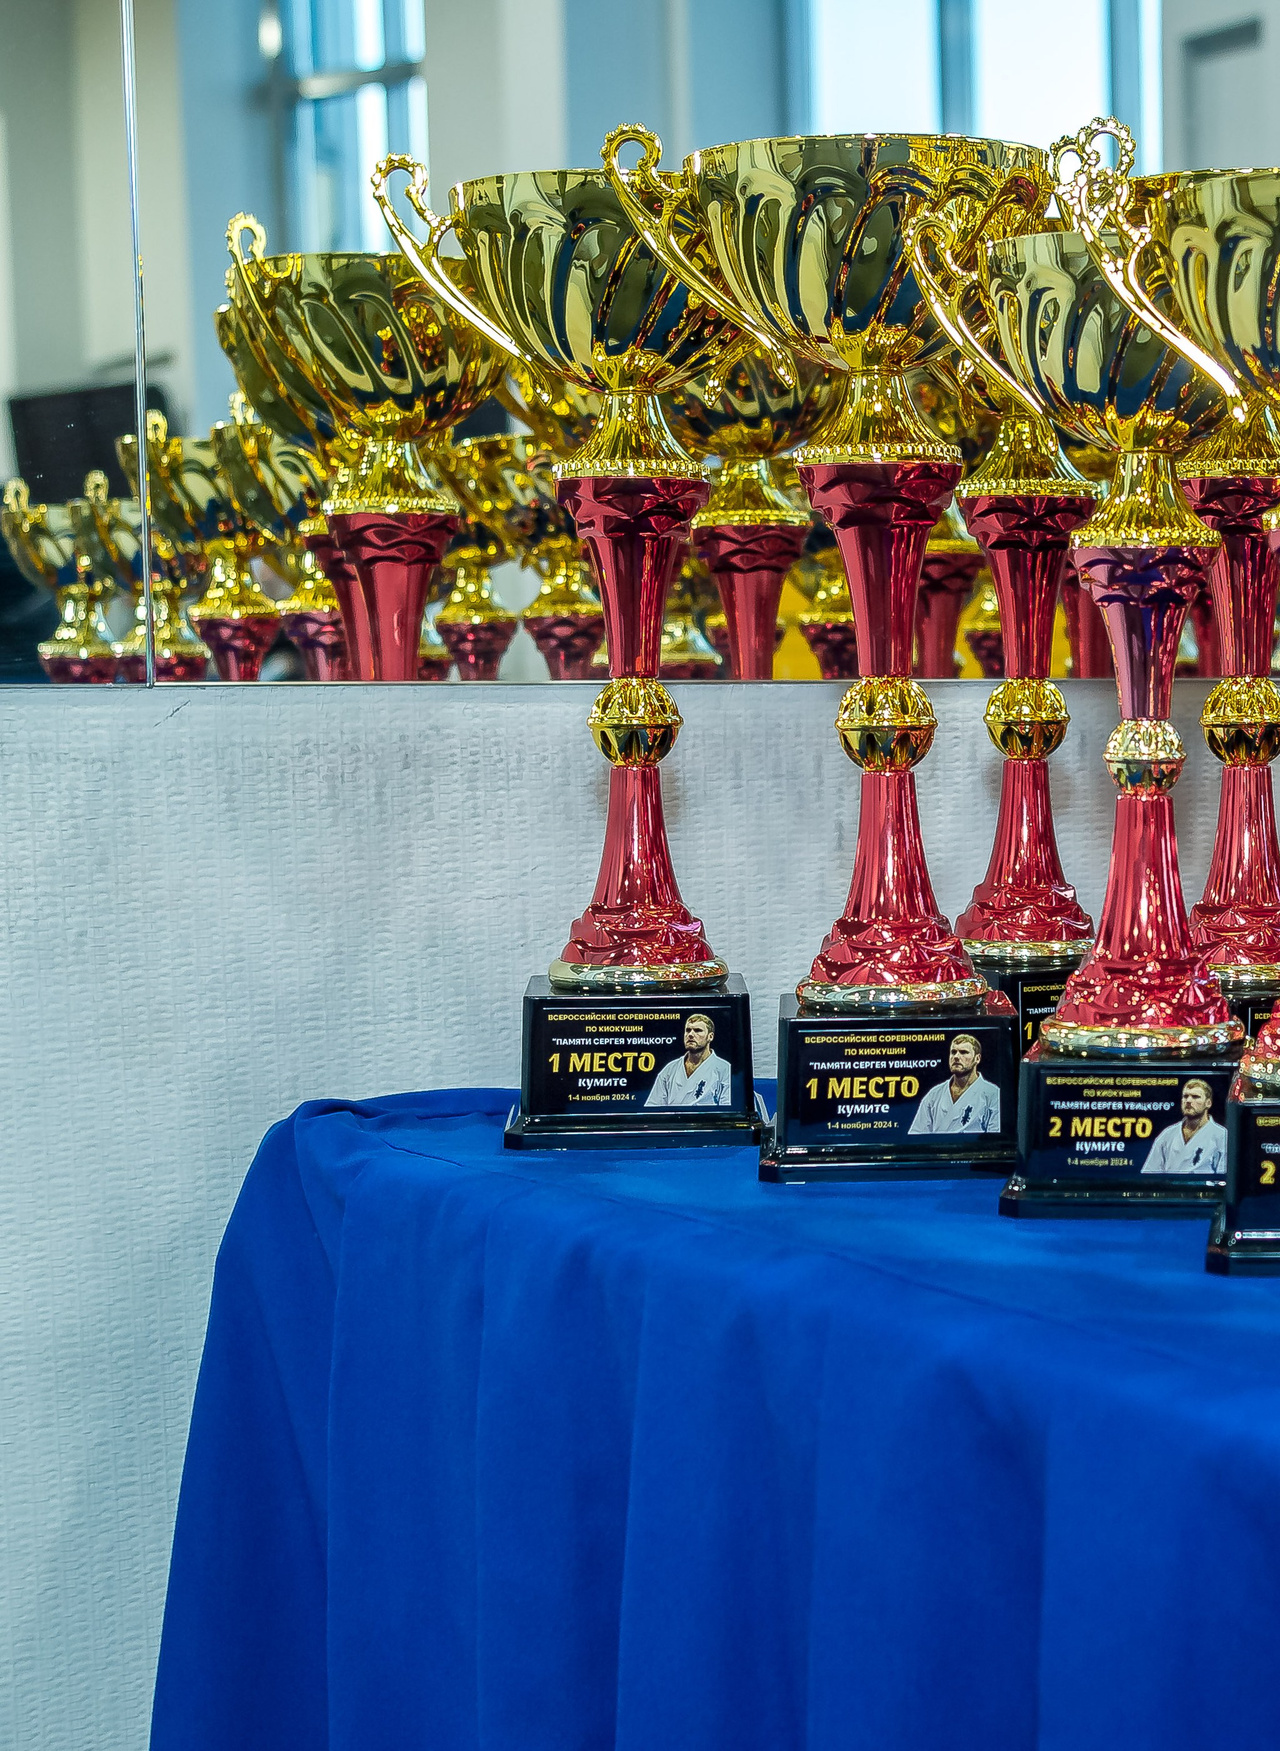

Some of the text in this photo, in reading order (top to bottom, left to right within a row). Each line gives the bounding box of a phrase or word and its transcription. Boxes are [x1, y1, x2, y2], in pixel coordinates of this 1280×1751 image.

[1023, 983, 1066, 992] ВСЕРОССИЙСК
[548, 1012, 616, 1020] ВСЕРОССИЙСКИЕ
[1024, 1021, 1033, 1040] 1
[552, 1036, 677, 1046] "ПАМЯТИ СЕРГЕЯ УВИЦКОГО"
[804, 1034, 945, 1043] ВСЕРОССИЙСКИЕ СОРЕВНОВАНИЯ
[858, 1047, 906, 1055] КИОКУШИН
[548, 1052, 656, 1073] 1 МЕСТО
[809, 1059, 942, 1070] "ПАМЯТИ СЕРГЕЯ УВИЦКОГО"
[578, 1077, 627, 1090] кумите
[805, 1076, 919, 1100] 1 МЕСТО
[581, 1094, 610, 1102] ноября
[611, 1093, 630, 1101] 2024
[837, 1104, 890, 1117] кумите
[1090, 1101, 1123, 1110] СЕРГЕЯ
[827, 1121, 839, 1130] 1-4
[840, 1121, 871, 1130] ноября
[873, 1120, 892, 1129] 2024
[1048, 1116, 1153, 1138] 2 МЕСТО
[1075, 1141, 1125, 1154] кумите
[1259, 1160, 1276, 1184] 2
